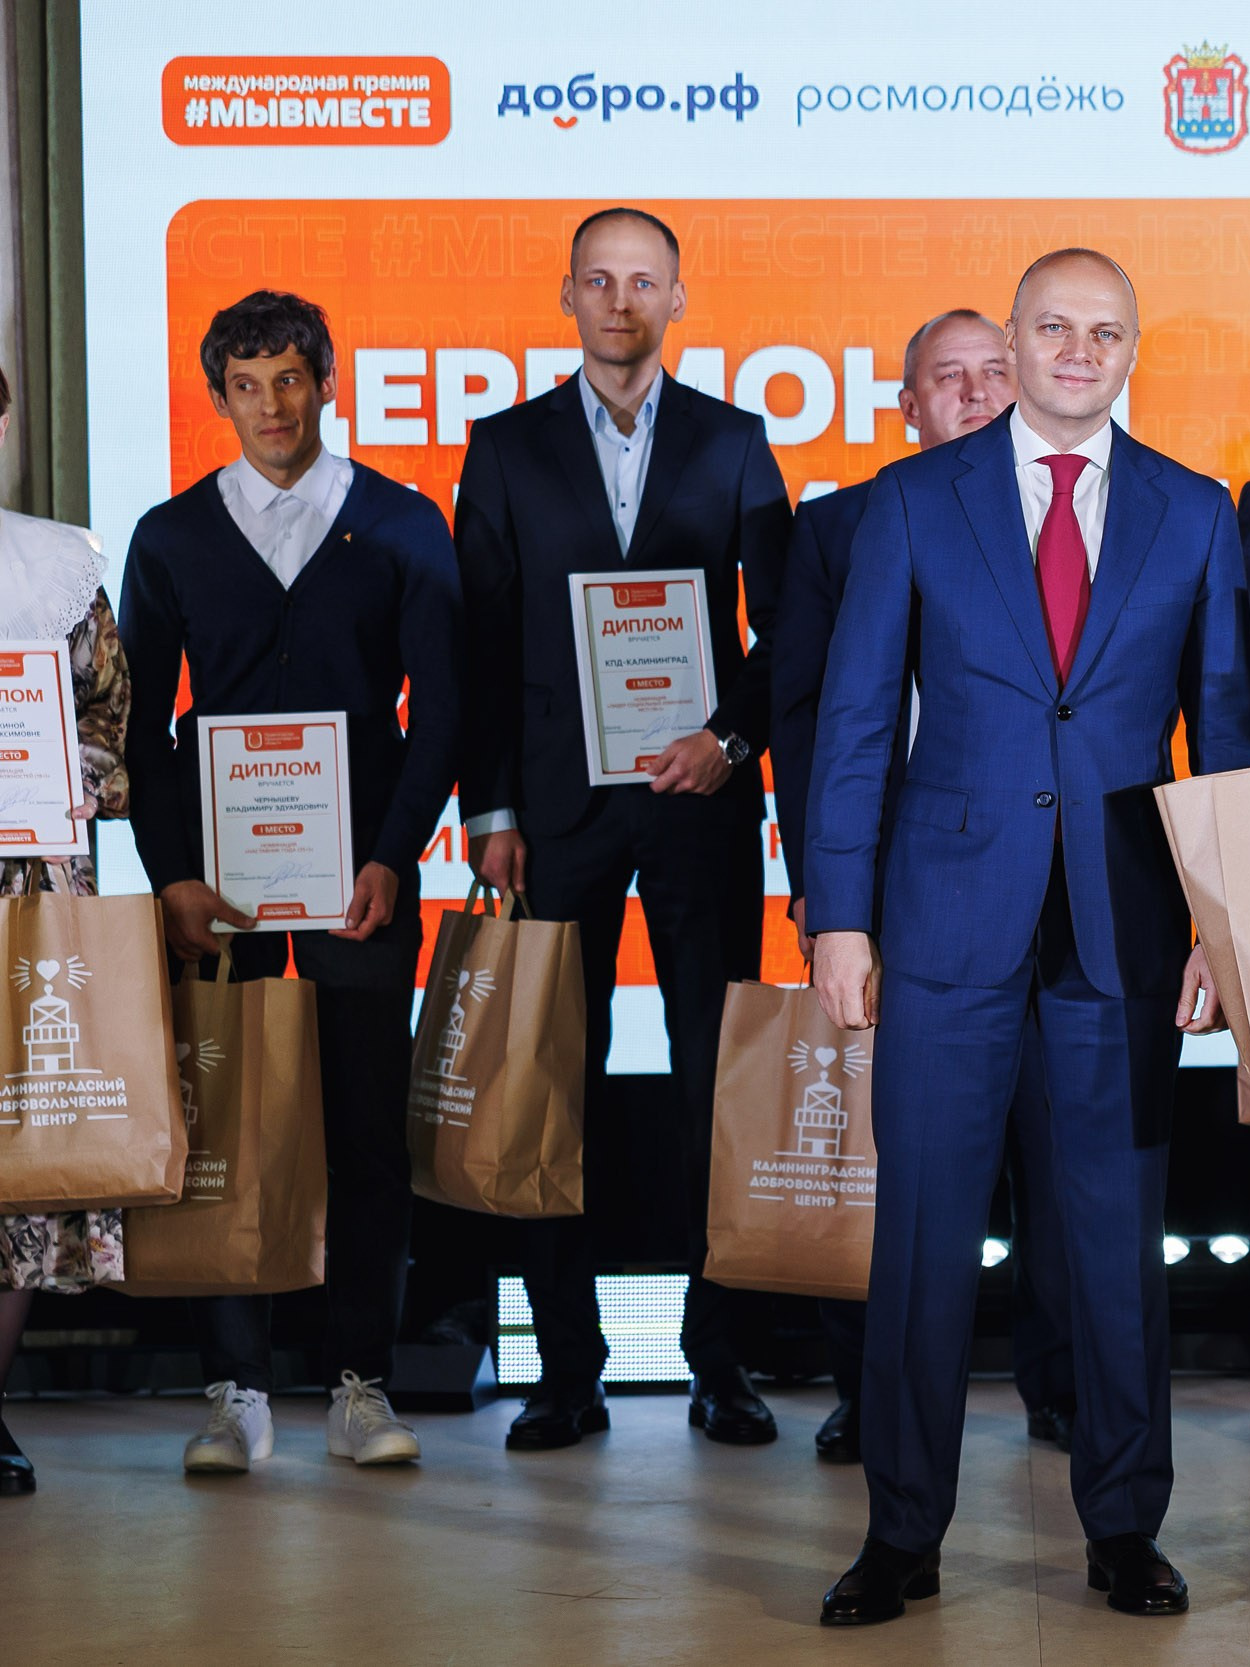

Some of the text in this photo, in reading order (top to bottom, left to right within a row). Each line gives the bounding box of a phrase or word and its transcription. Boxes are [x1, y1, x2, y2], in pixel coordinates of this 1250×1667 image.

[184, 75, 431, 96] международная премия
[497, 72, 760, 123] добро.рф
[796, 77, 1125, 126] росмолодёжь
[184, 98, 431, 128] #МЫВМЕСТЕ
[601, 616, 684, 638] ДИПЛОМ
[604, 656, 689, 668] КПД-КАЛИНИНГРАД
[637, 680, 665, 688] МЕСТО
[229, 761, 321, 781] ДИПЛОМ
[225, 804, 329, 813] ВЛАДИМИРУ ЭДУАРДОВИЧУ
[254, 796, 300, 804] ЧЕРНЫШЕВУ
[265, 825, 296, 833] МЕСТО
[31, 1113, 77, 1127] ЦЕНТР
[752, 1160, 877, 1179] КАЛИНИНГРАДСКИ
[749, 1175, 876, 1194] ДОБРОВОЛЬЧЕСКИ
[794, 1194, 837, 1207] ЦЕНТР
